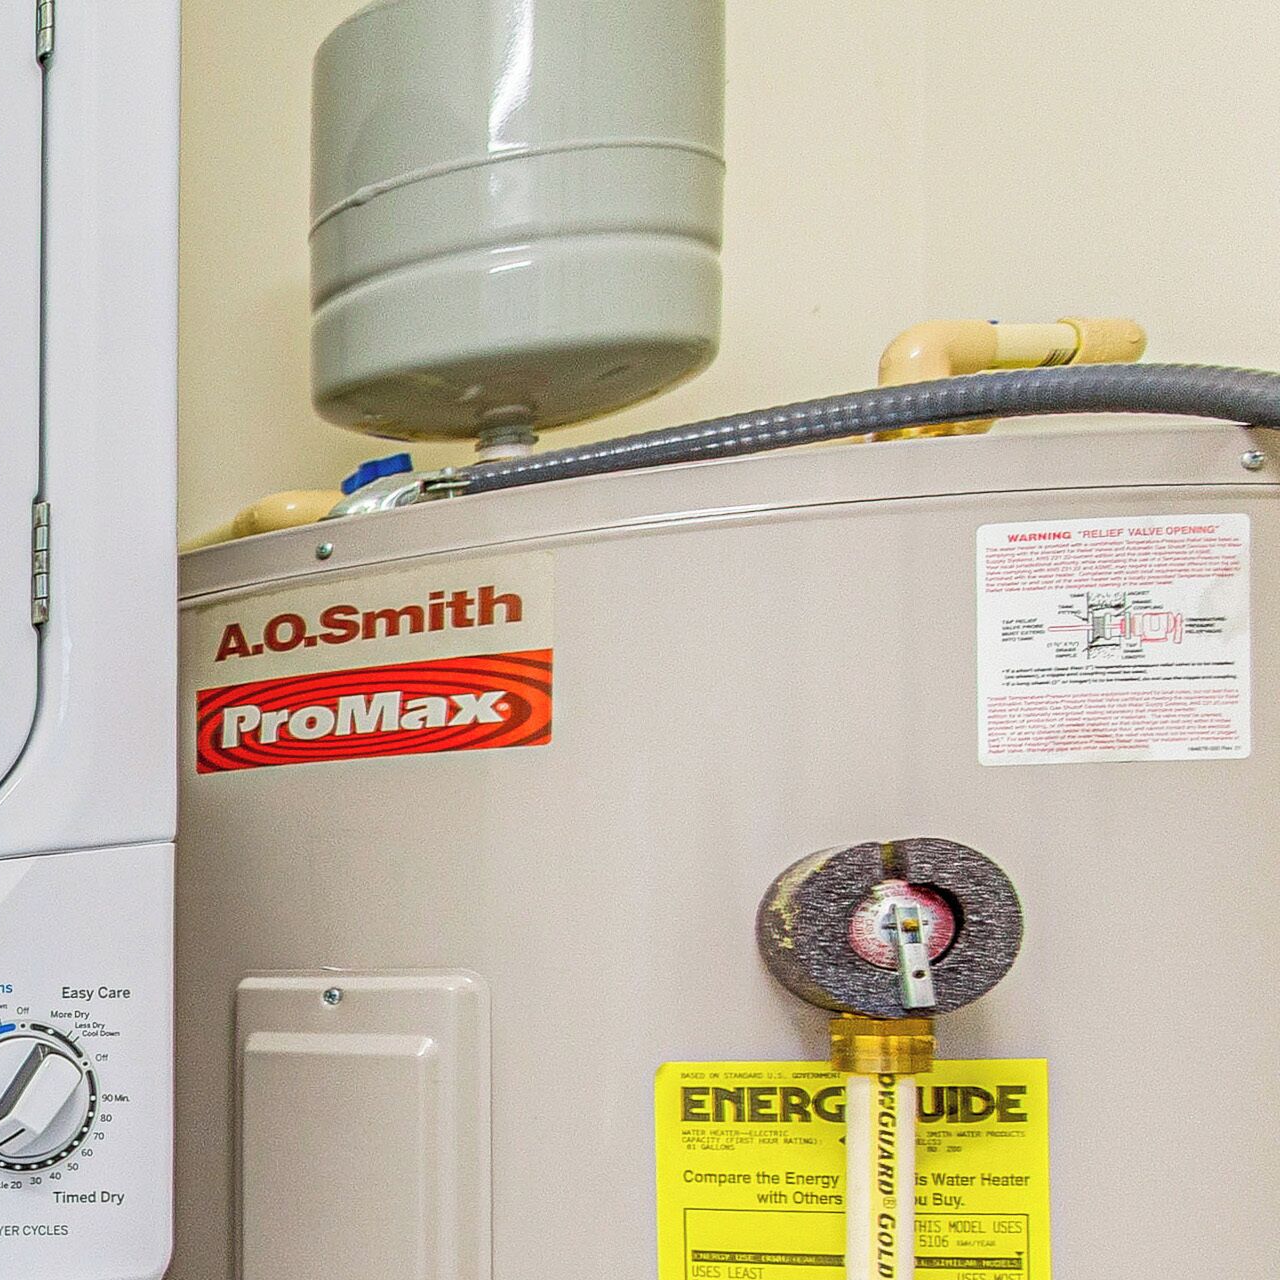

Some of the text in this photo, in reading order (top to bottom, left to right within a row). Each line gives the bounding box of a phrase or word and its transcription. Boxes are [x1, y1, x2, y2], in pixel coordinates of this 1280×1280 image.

[1007, 531, 1072, 543] WARNING
[1128, 527, 1165, 537] VALVE
[215, 585, 523, 663] A.O.Smith
[61, 987, 131, 1000] Easy Care
[16, 1006, 30, 1015] Off
[50, 1010, 90, 1020] More Dry
[95, 1053, 109, 1062] Off
[101, 1094, 113, 1102] 90
[100, 1114, 112, 1122] 80
[93, 1132, 105, 1140] 70
[81, 1149, 93, 1157] 60
[67, 1163, 79, 1171] 50
[29, 1177, 42, 1185] 30
[49, 1172, 62, 1180] 40
[683, 1169, 752, 1187] Compare
[755, 1171, 781, 1185] the
[785, 1171, 840, 1189] Energy
[931, 1172, 977, 1187] Water
[980, 1173, 1031, 1187] Heater
[10, 1181, 22, 1189] 20
[52, 1191, 125, 1205] Timed Dry
[757, 1190, 788, 1205] with
[792, 1191, 843, 1205] Others
[932, 1193, 965, 1210] Buy.
[22, 1225, 69, 1236] CYCLES
[948, 1221, 987, 1233] MODEL
[993, 1221, 1022, 1233] USES
[919, 1235, 949, 1248] 5106
[691, 1265, 765, 1280] USES LEAST
